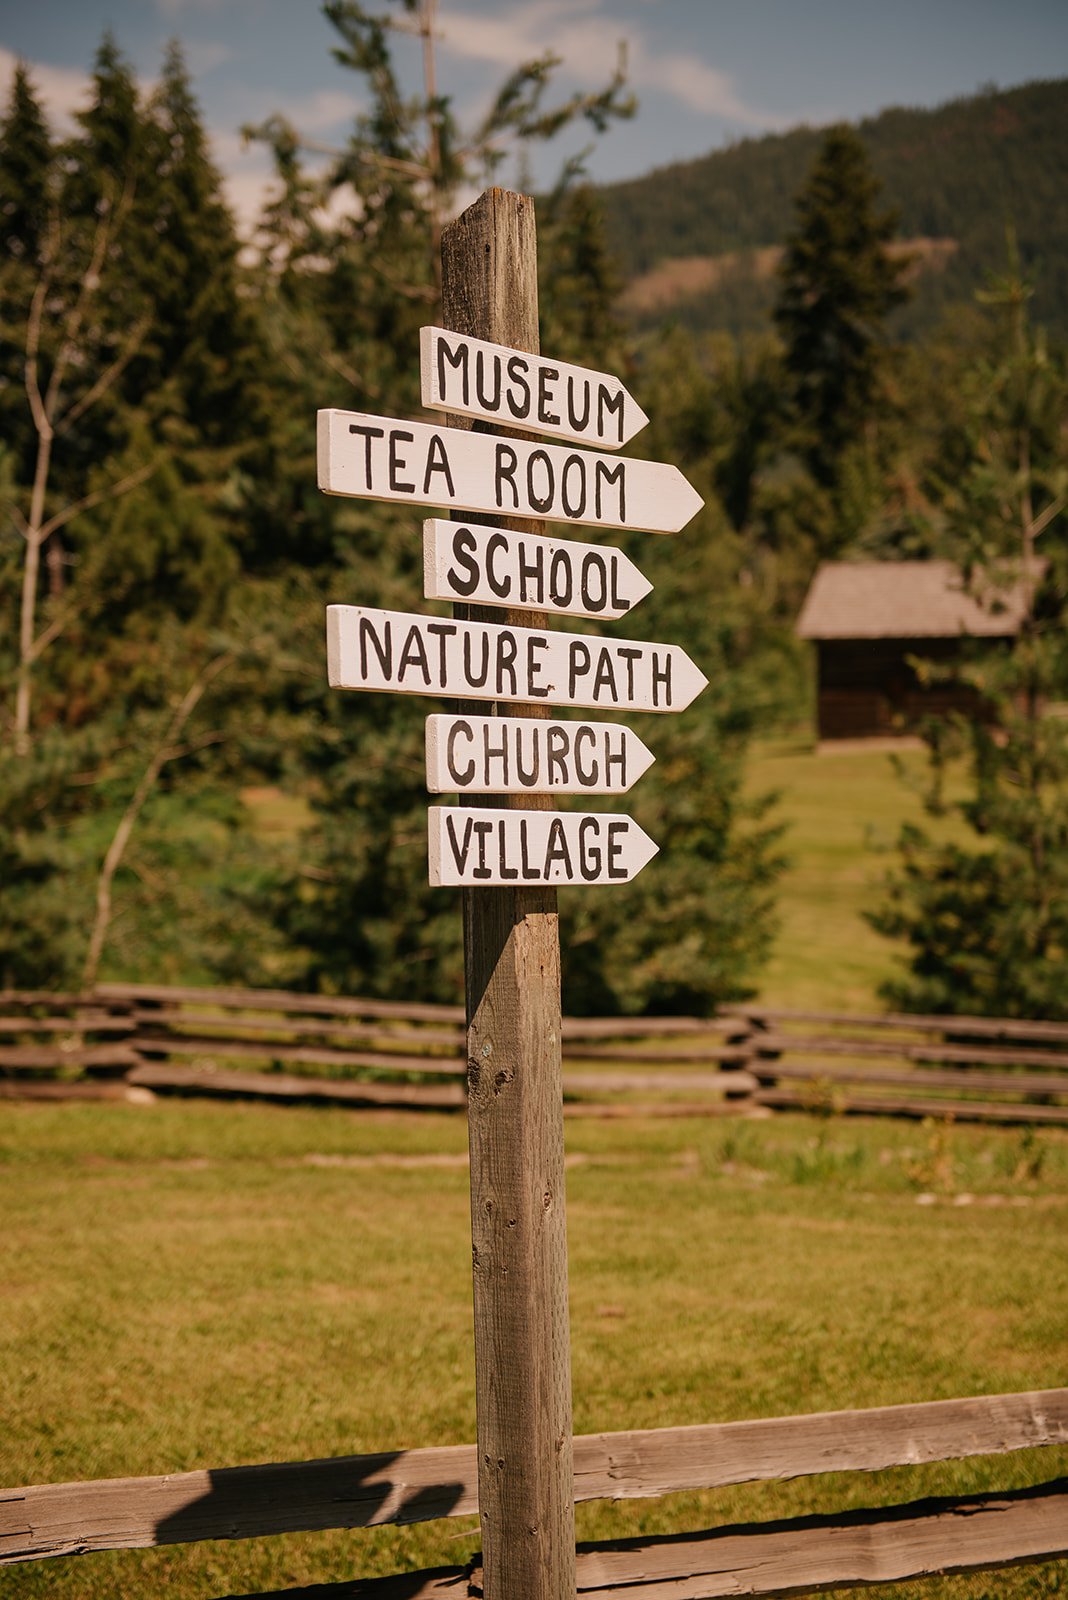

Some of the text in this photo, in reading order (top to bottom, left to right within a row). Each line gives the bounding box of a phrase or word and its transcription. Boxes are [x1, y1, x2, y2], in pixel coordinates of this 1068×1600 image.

[437, 336, 625, 442] MUSEUM
[349, 424, 626, 523] TEA ROOM
[447, 527, 631, 612] SCHOOL
[359, 617, 673, 707] NATURE PATH
[448, 720, 627, 787] CHURCH
[446, 814, 629, 881] VILLAGE
